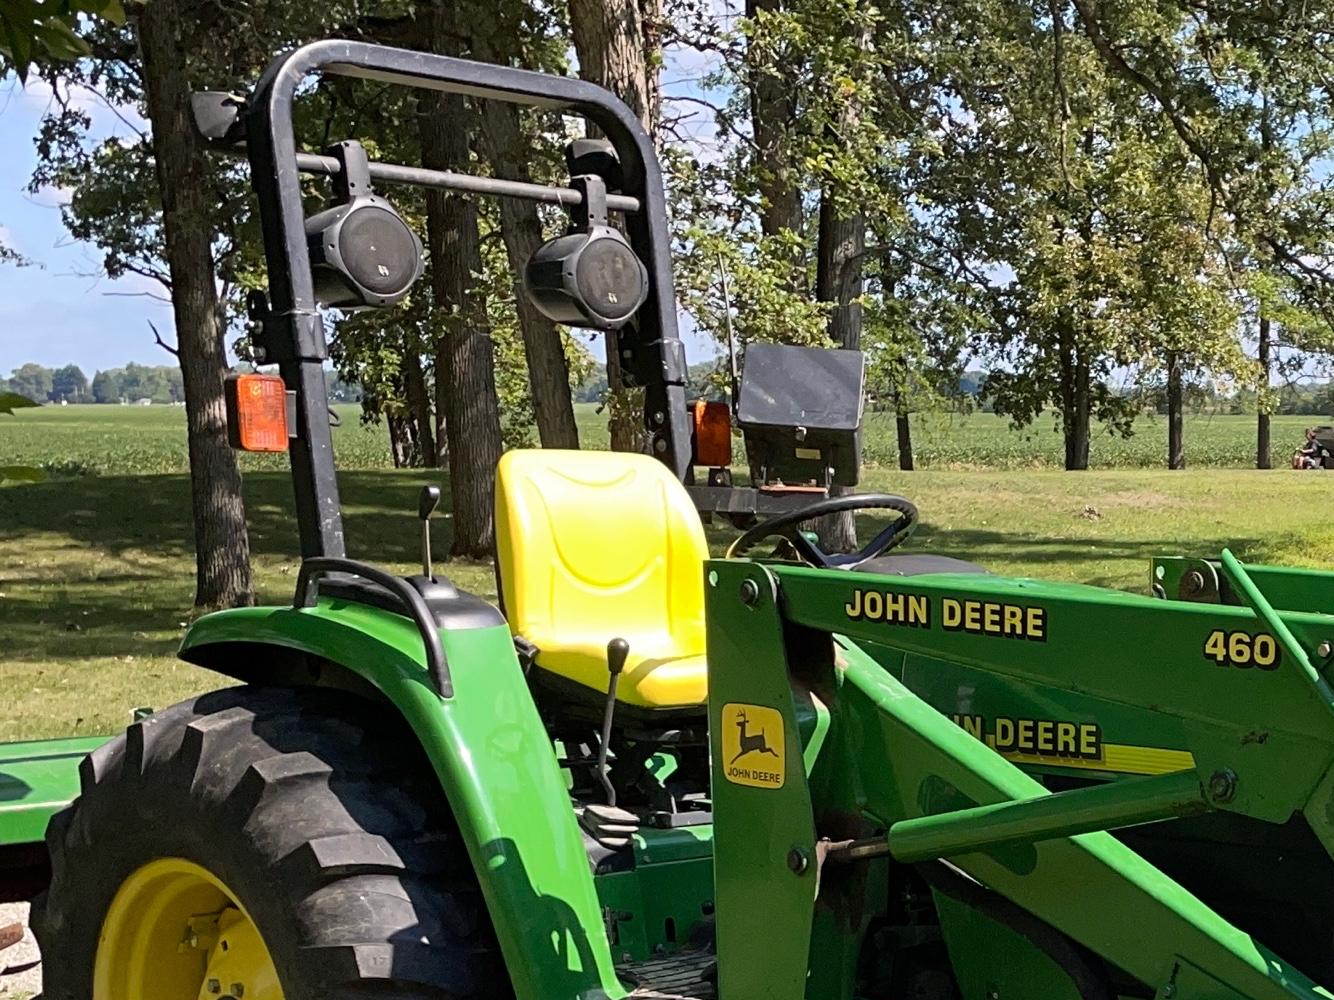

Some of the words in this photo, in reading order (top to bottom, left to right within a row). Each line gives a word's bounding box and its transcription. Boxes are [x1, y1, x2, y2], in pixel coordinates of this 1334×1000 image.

[845, 589, 928, 625] JOHN
[942, 598, 1044, 638] DEERE
[1205, 631, 1276, 665] 460
[995, 717, 1097, 754] DEERE
[727, 767, 751, 778] JOHN
[752, 770, 780, 783] DEERE
